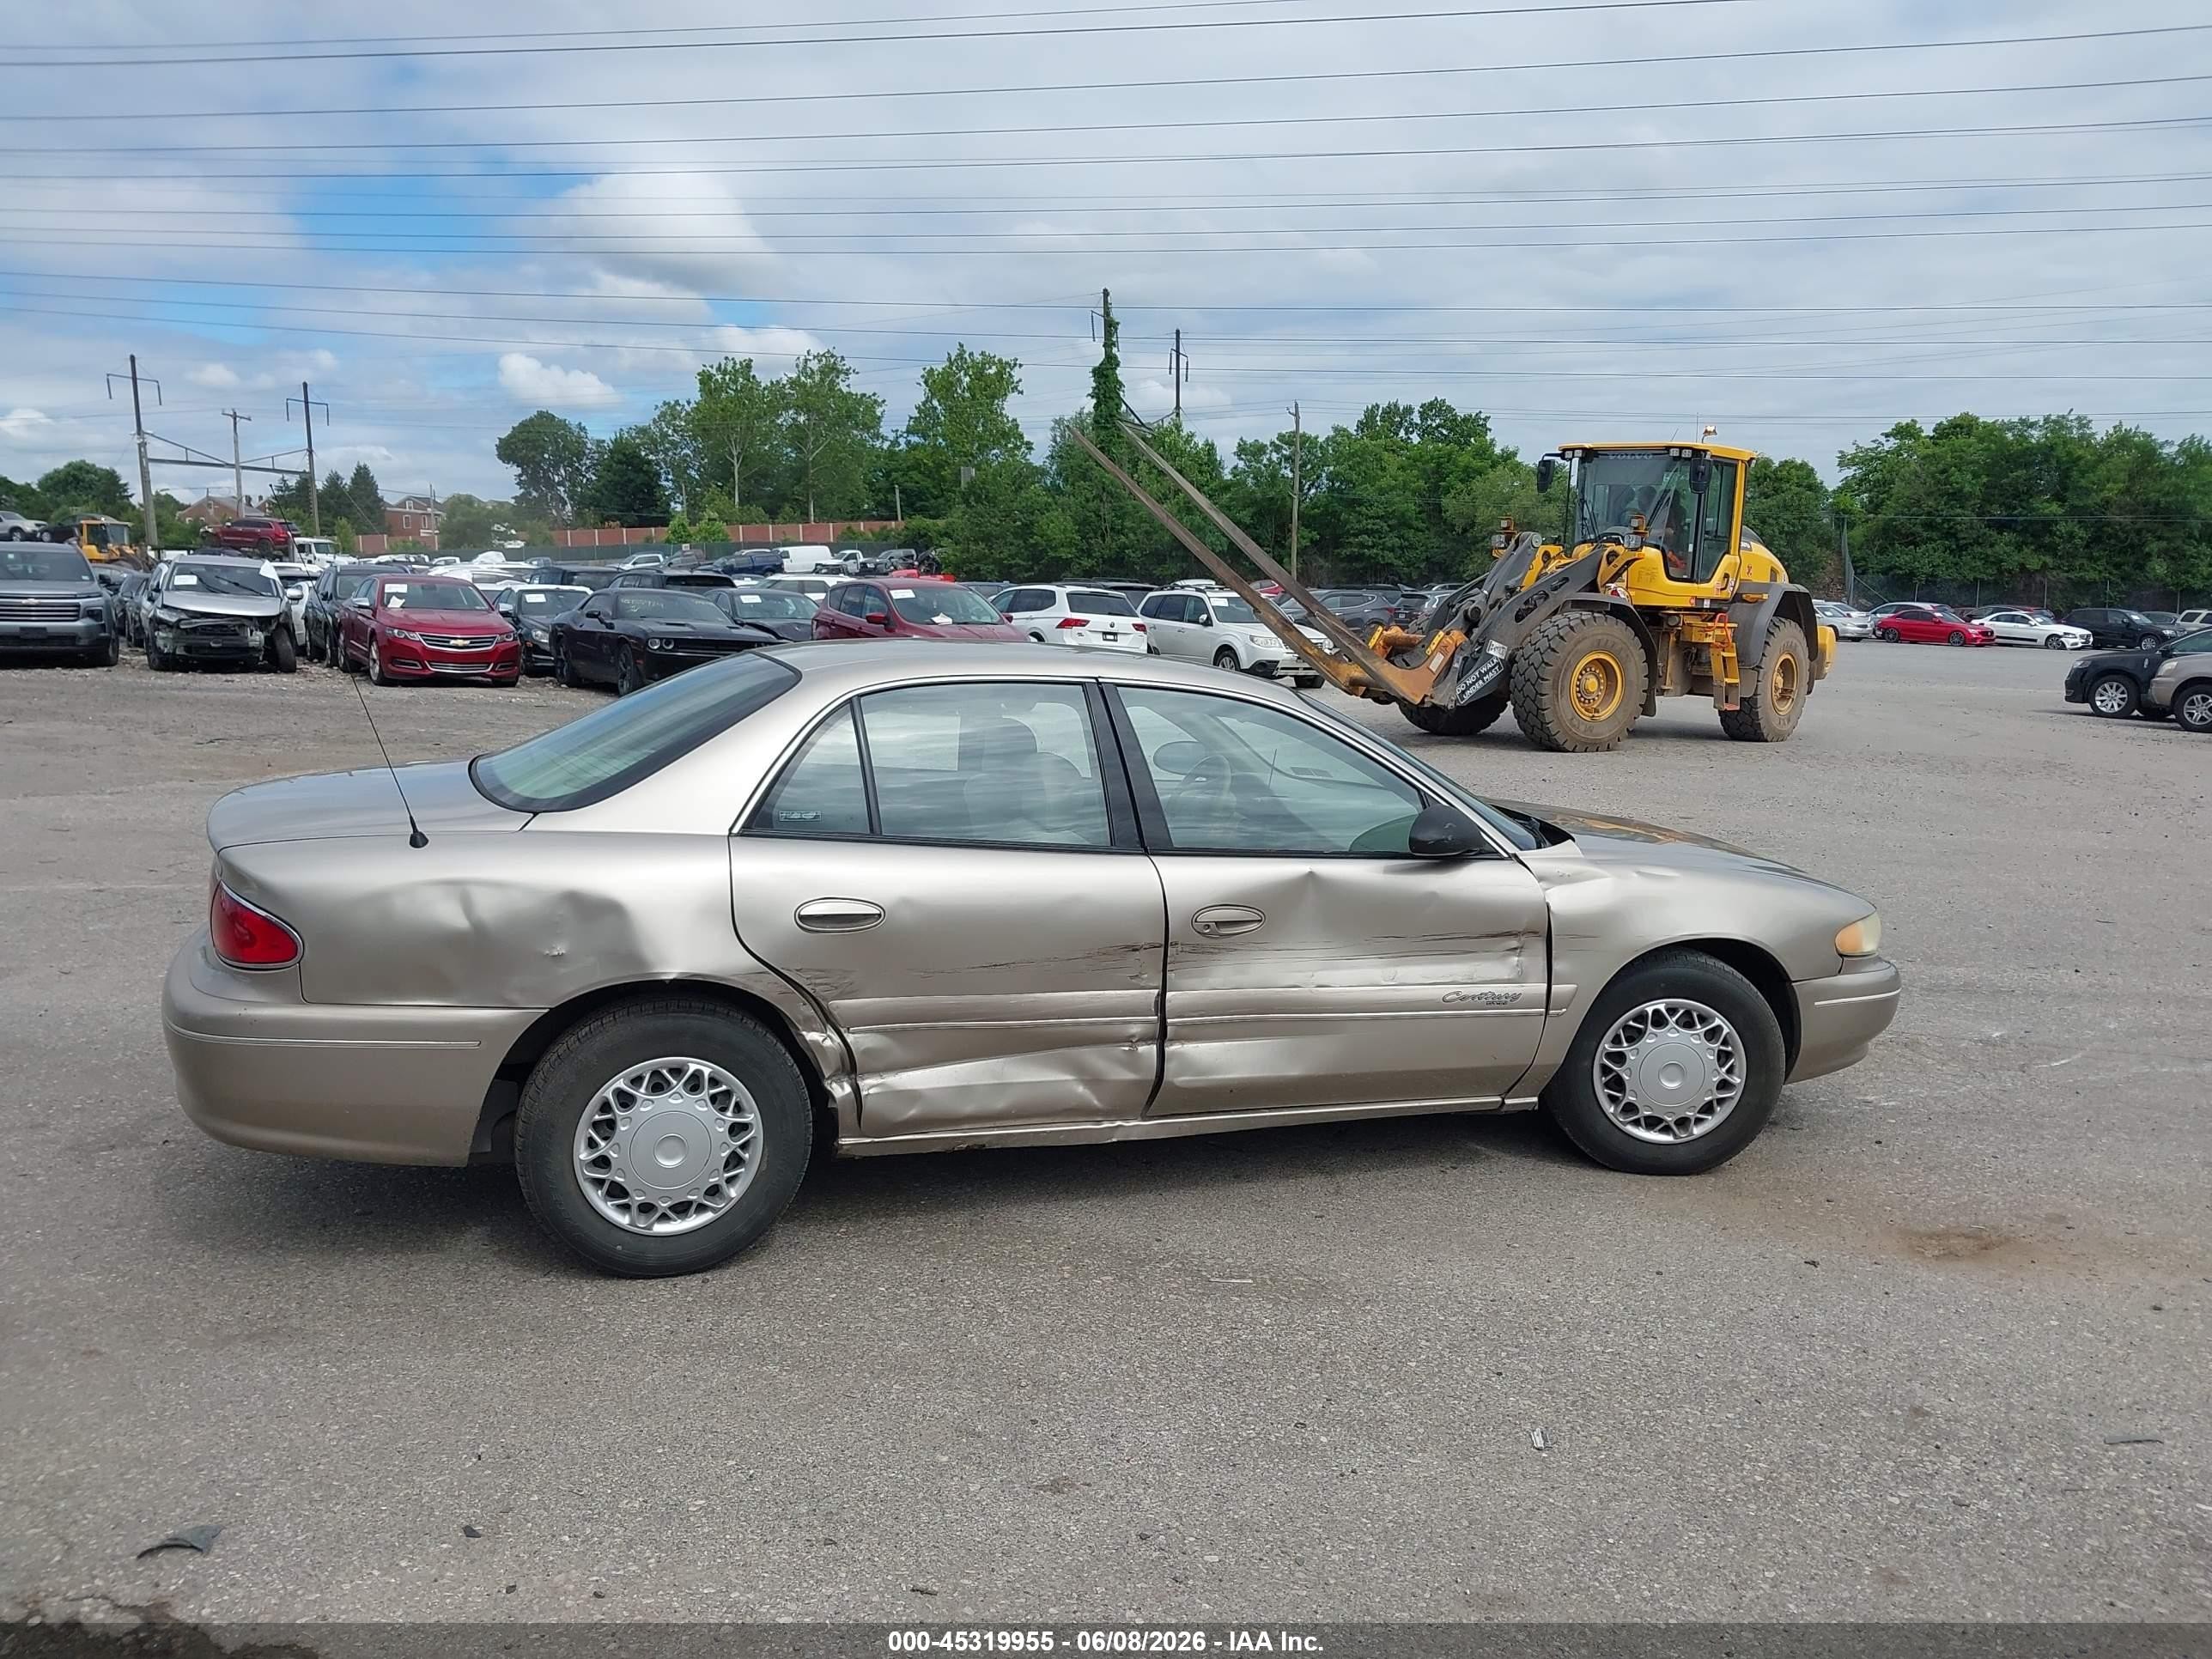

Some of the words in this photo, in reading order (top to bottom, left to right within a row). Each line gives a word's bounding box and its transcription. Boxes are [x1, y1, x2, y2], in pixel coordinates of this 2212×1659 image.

[1456, 684, 1466, 694] DO
[1467, 672, 1480, 686] NOT
[1480, 657, 1498, 673] WALK
[1463, 679, 1483, 698] UNDER
[1484, 666, 1500, 682] MAST
[1442, 990, 1522, 1003] Century
